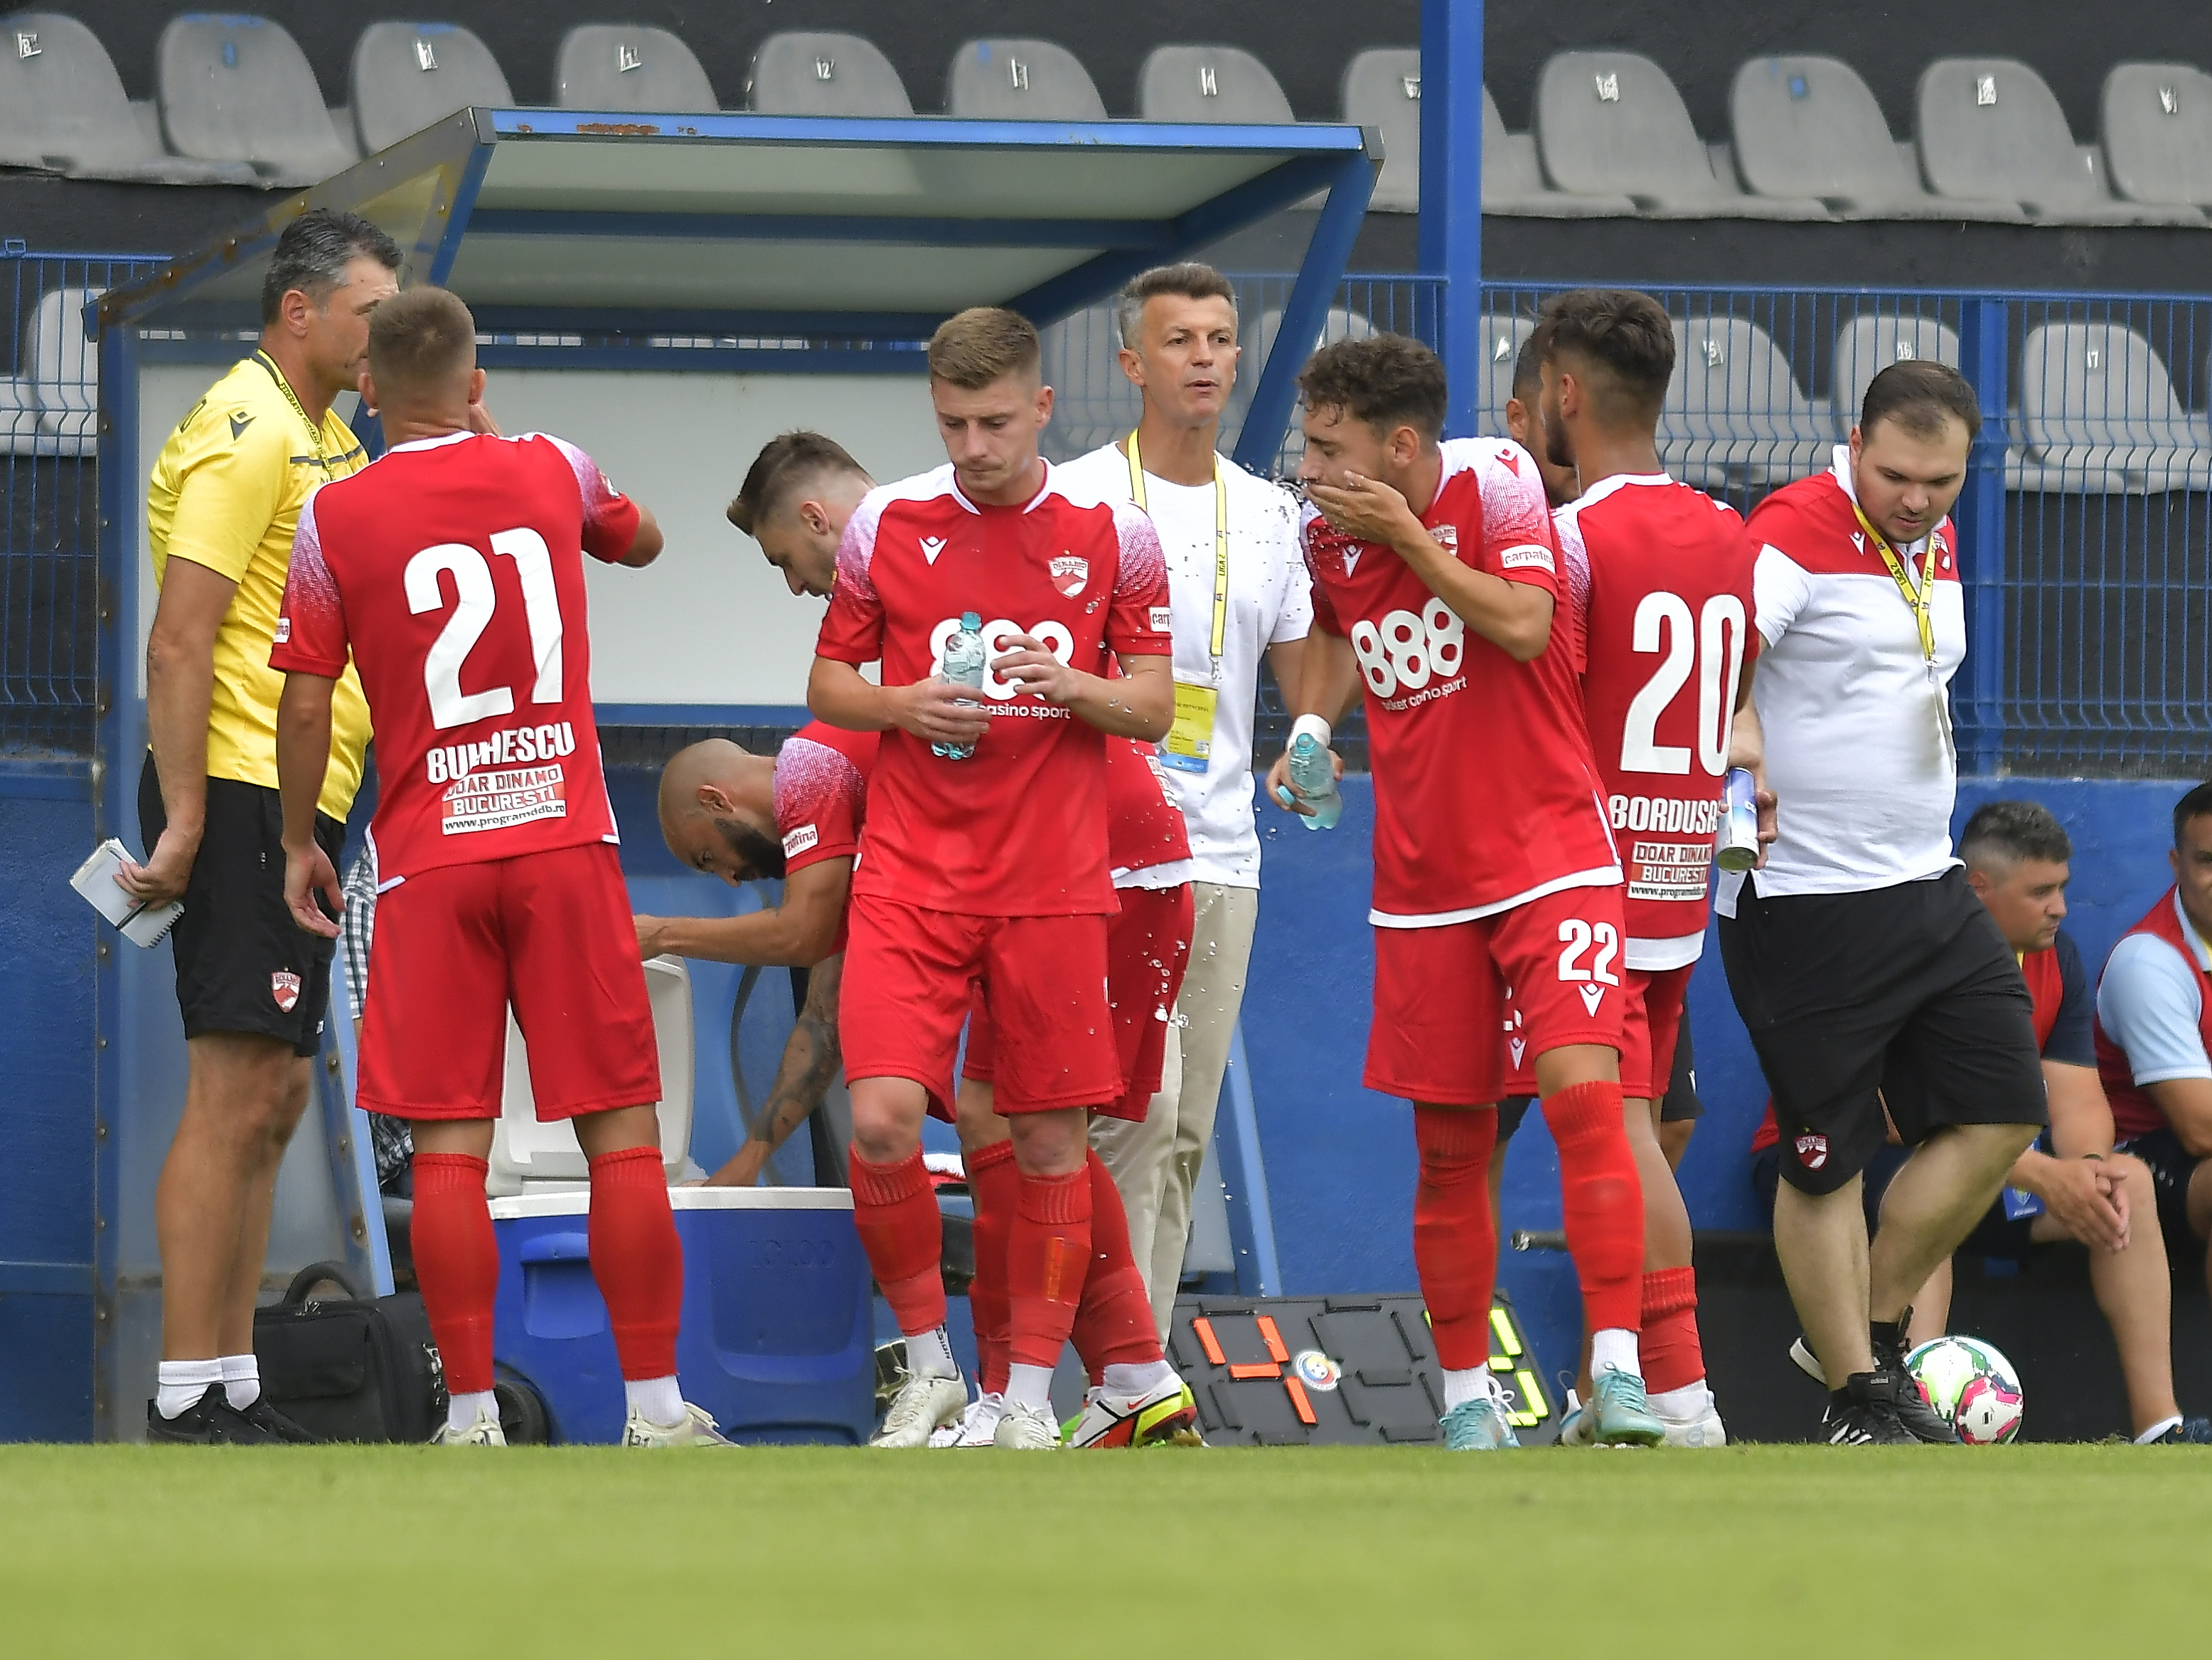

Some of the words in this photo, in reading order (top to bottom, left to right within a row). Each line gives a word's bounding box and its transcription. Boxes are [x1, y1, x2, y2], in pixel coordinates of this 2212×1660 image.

[404, 527, 562, 730] 21
[1352, 596, 1465, 698] 888
[1620, 592, 1746, 776] 20
[1031, 706, 1071, 720] sport
[496, 768, 558, 789] DINAMO
[453, 786, 555, 816] BUCURESTI
[1609, 795, 1719, 834] BORDUSA
[1636, 844, 1675, 863] DOAR
[1642, 865, 1707, 883] BUCURESTI
[1558, 919, 1620, 987] 22
